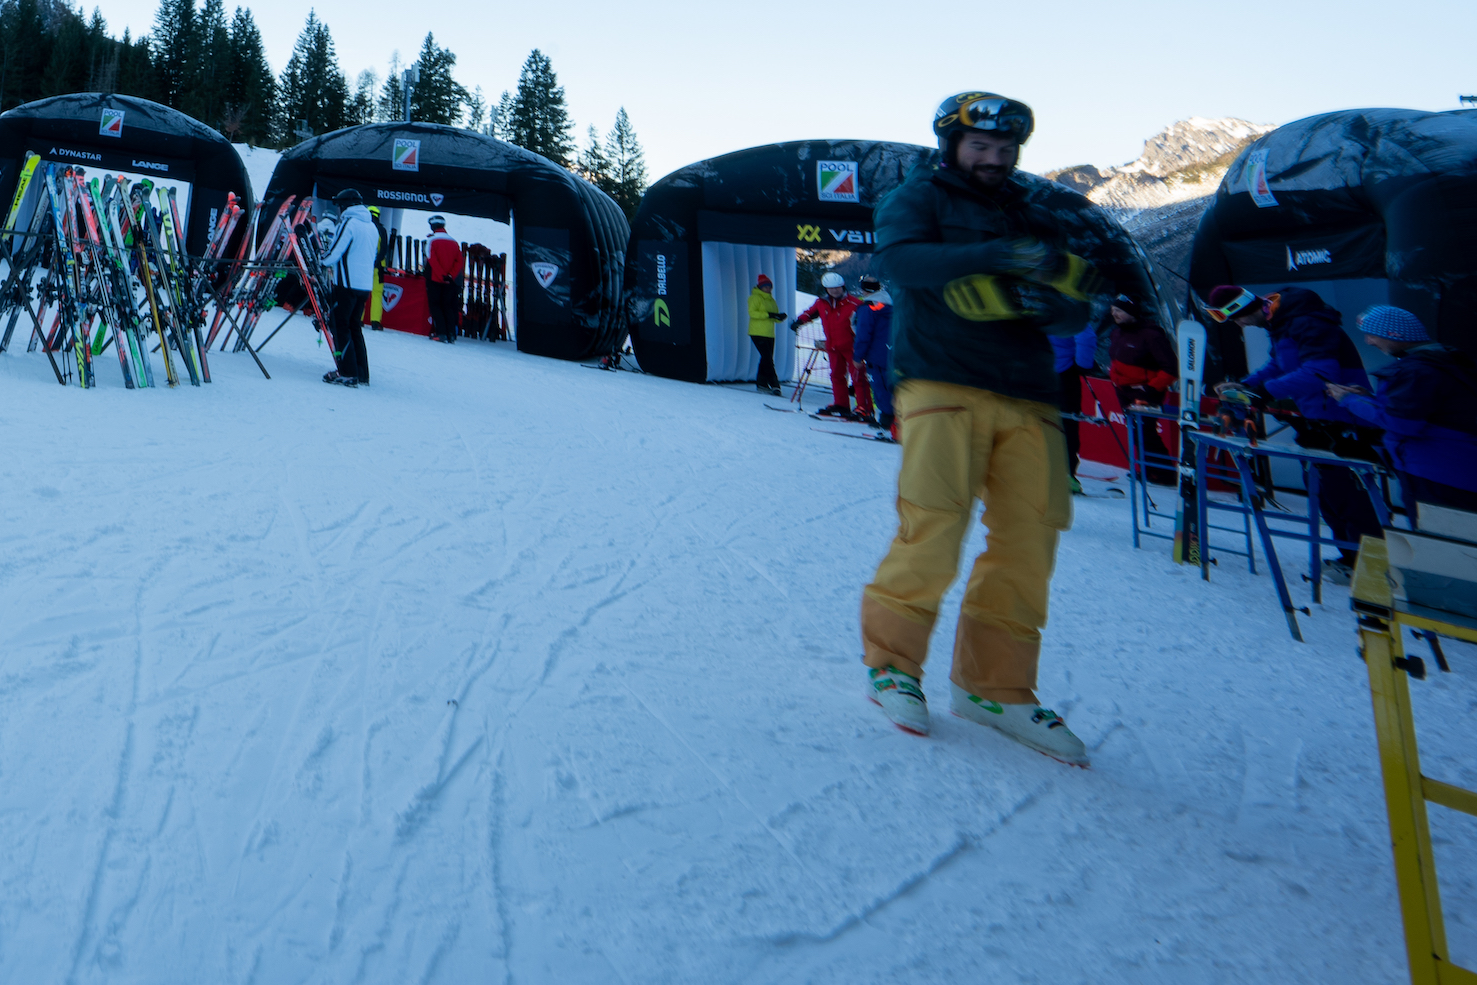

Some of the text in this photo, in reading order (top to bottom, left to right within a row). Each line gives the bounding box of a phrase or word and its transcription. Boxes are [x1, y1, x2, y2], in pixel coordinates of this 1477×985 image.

[396, 140, 417, 148] POOL
[58, 148, 169, 172] DYNASTAR LANGE
[820, 162, 854, 172] POOL
[376, 189, 431, 204] ROSSIGNOL
[1294, 248, 1332, 266] ATOMIC
[656, 253, 668, 296] DALBELLO
[1187, 337, 1195, 372] SALOMON
